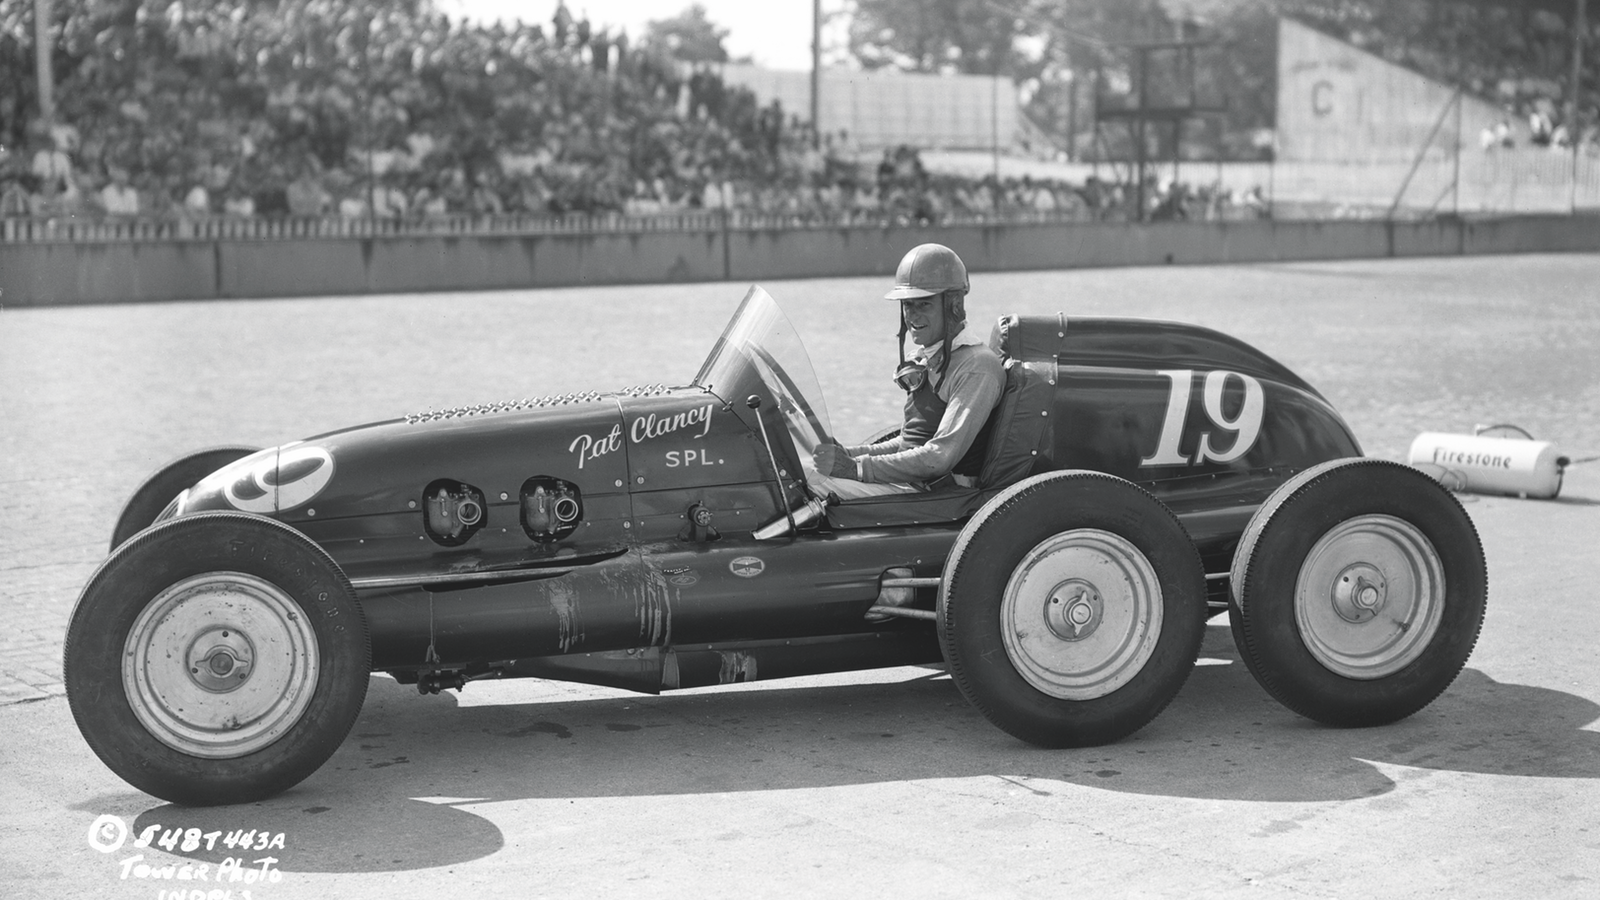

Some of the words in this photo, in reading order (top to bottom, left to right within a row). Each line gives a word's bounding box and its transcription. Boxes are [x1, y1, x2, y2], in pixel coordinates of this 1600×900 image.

[1310, 80, 1335, 119] C
[568, 423, 622, 469] Pat
[630, 404, 714, 444] Clancy
[1140, 369, 1265, 466] 19
[665, 449, 725, 468] SPL.
